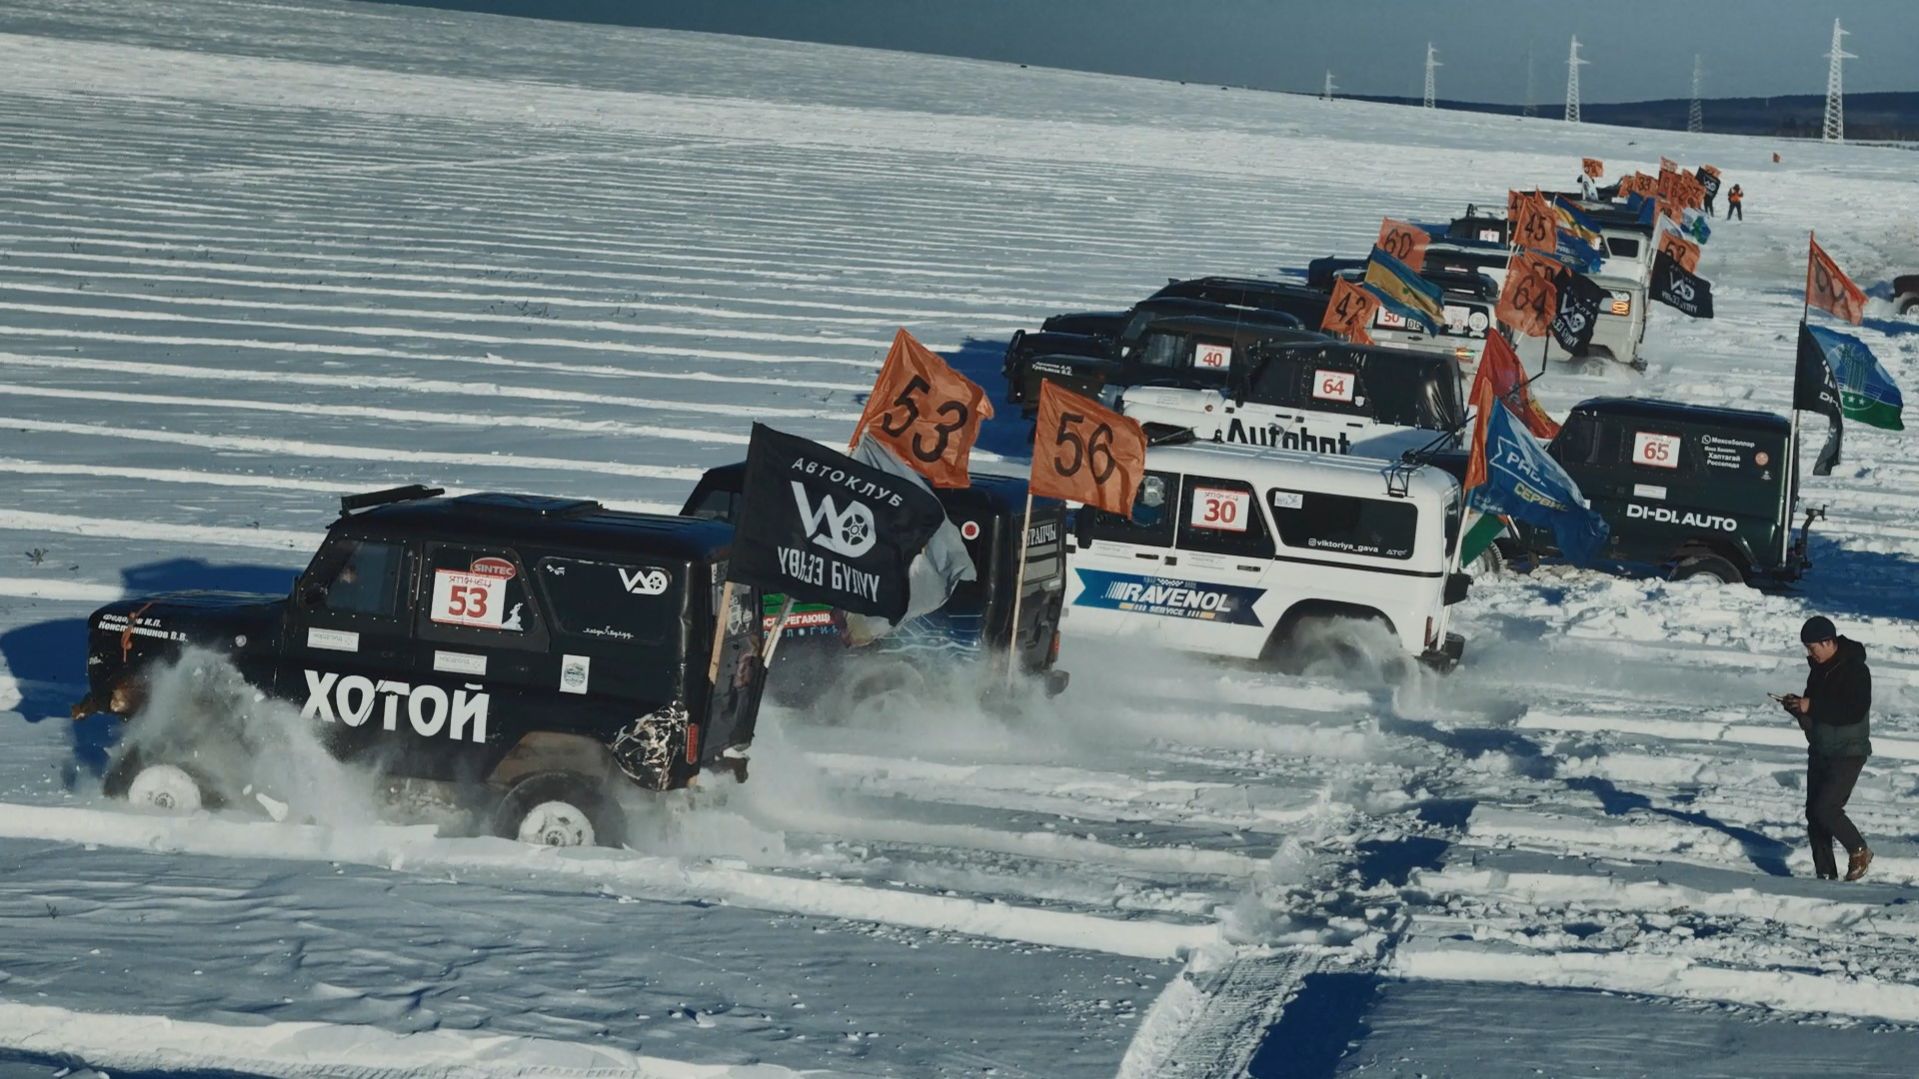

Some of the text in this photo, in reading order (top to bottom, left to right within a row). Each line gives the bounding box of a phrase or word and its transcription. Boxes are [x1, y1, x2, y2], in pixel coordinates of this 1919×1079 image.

[1525, 212, 1546, 241] 45
[1384, 228, 1414, 260] 60
[1513, 276, 1548, 319] 64
[1203, 351, 1223, 368] 40
[1322, 378, 1344, 396] 64
[881, 374, 969, 463] 53
[1054, 411, 1116, 485] 56
[1643, 441, 1669, 461] 65
[791, 456, 903, 508] АВТОКЛУБ
[1203, 498, 1237, 524] 30
[474, 563, 513, 576] SINTEC
[448, 584, 488, 618] 53
[1122, 581, 1233, 613] RAVENOL
[1149, 605, 1185, 617] SERVICE
[299, 668, 491, 744] ХОТОЙ
